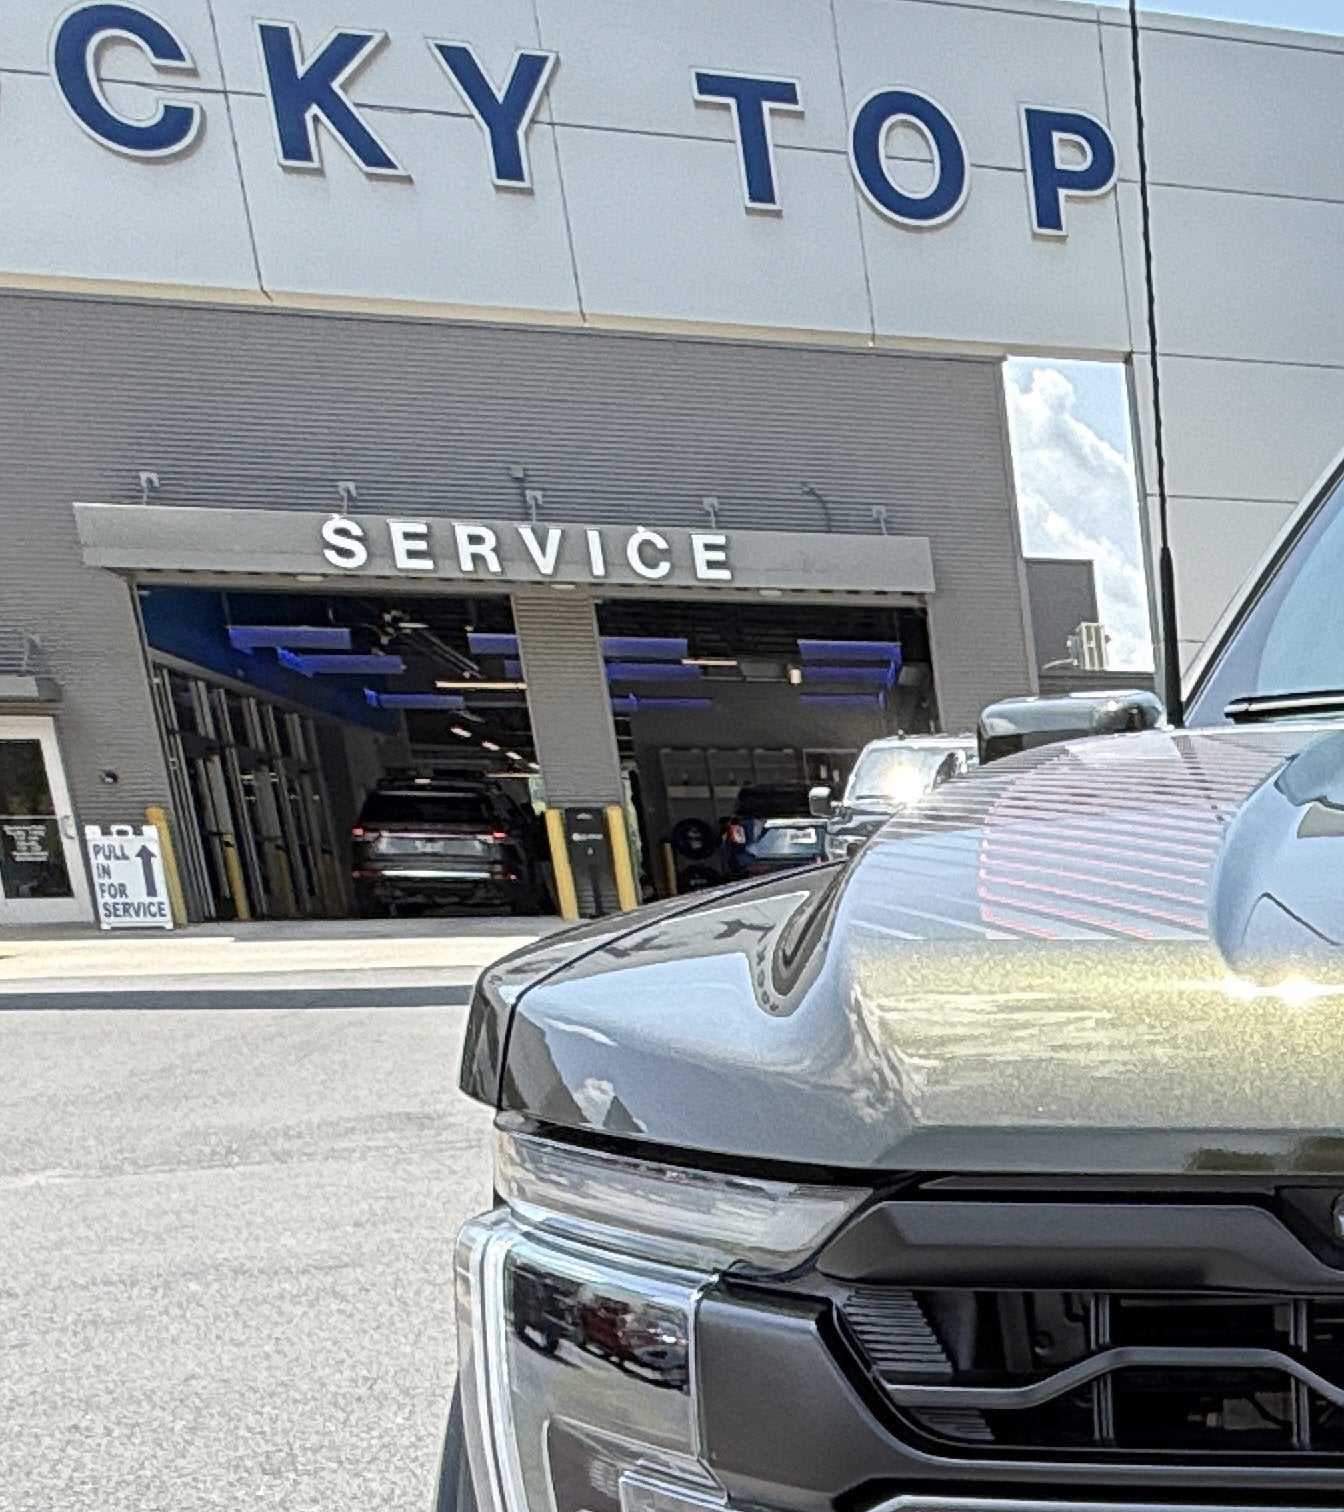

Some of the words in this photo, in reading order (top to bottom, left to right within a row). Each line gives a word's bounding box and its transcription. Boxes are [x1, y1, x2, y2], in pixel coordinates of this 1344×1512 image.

[49, 1, 558, 190] CKY
[692, 67, 1118, 237] TOP
[321, 515, 732, 581] SERVICE
[92, 843, 130, 861] PULL
[96, 863, 112, 880] IN
[99, 882, 130, 900] FOR
[102, 901, 168, 918] SERVICE
